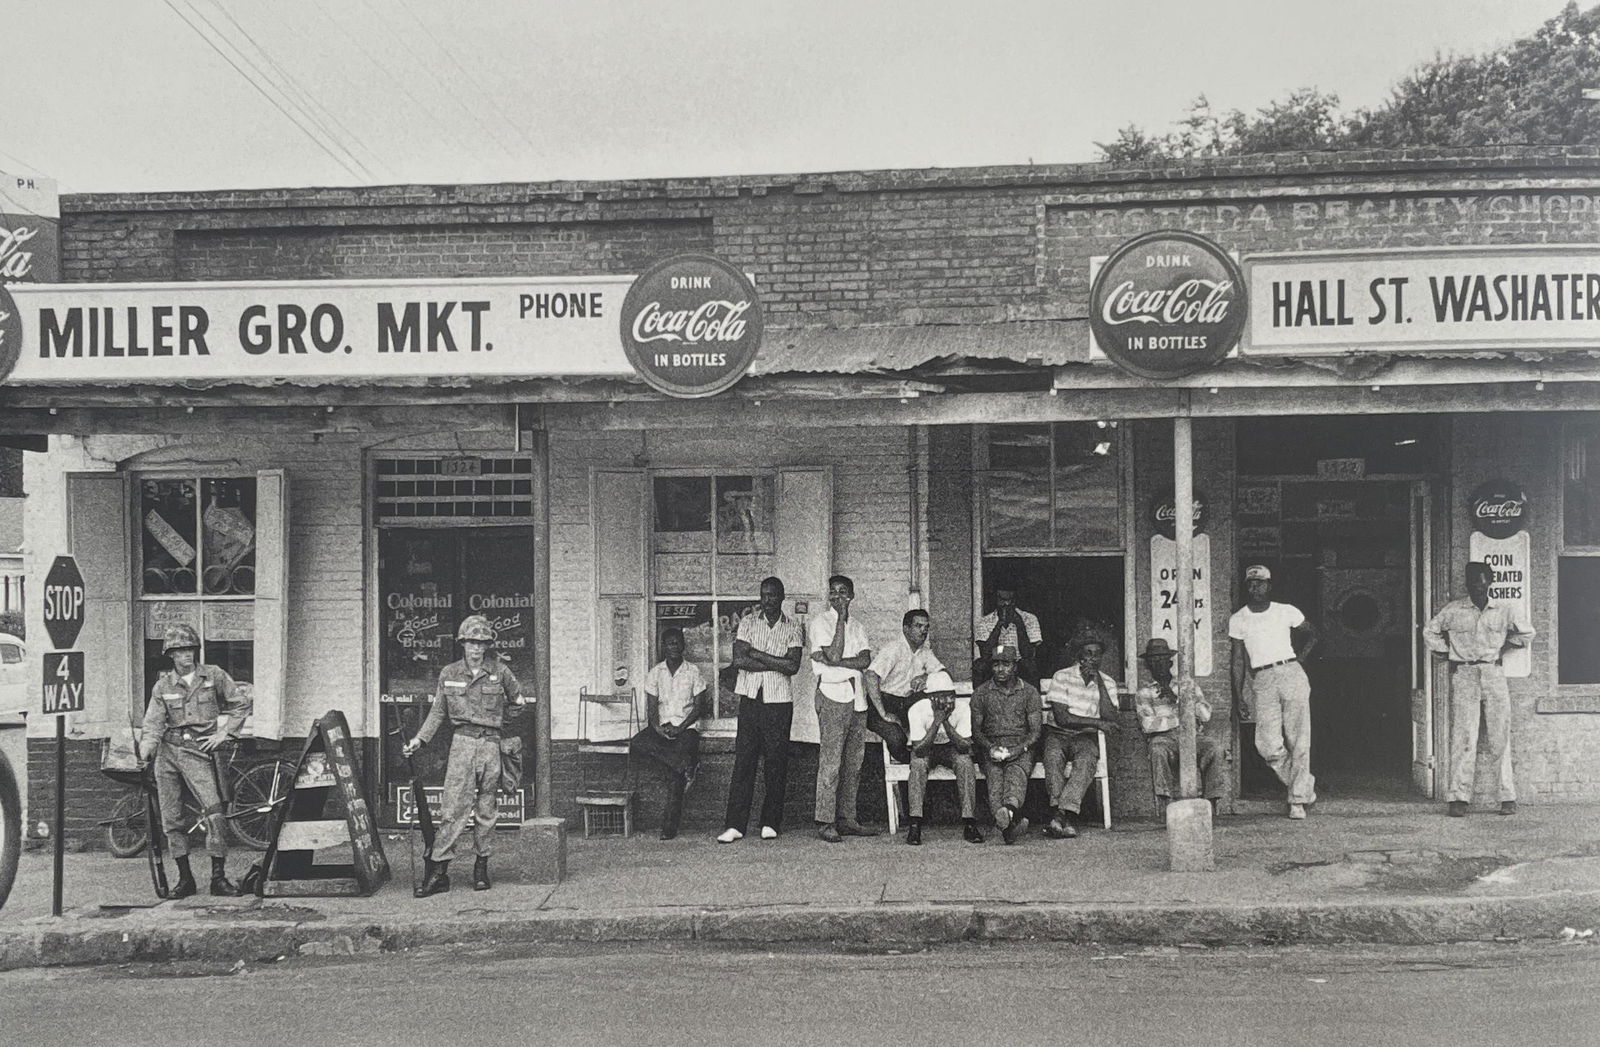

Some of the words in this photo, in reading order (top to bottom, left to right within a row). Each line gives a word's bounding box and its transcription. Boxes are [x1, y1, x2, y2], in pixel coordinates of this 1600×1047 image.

[1146, 255, 1191, 267] DRINK
[671, 276, 711, 289] DRINK
[1102, 279, 1234, 325] Coca-Cola
[1272, 279, 1354, 328] HALL
[1368, 277, 1412, 325] ST.
[1429, 273, 1600, 323] WASHATER
[40, 305, 210, 358] MILLER
[238, 303, 353, 355] GRO.
[377, 301, 493, 353] MKT.
[519, 293, 603, 319] PHONE
[632, 300, 752, 342] Coca-Cola
[1127, 337, 1144, 350] IN
[1149, 336, 1207, 350] BOTTLES
[654, 354, 669, 367] IN
[672, 353, 726, 367] BOTTLES
[1476, 500, 1523, 518] Coca-Cola
[1484, 554, 1513, 567] COIN
[1160, 568, 1202, 581] OPN
[1492, 570, 1523, 583] ERATED
[1489, 586, 1522, 600] ASHERS
[45, 585, 83, 620] STOP
[387, 593, 453, 610] Colonial
[469, 593, 534, 611] Colonial
[673, 606, 697, 616] SELL
[403, 637, 442, 649] Bread
[491, 637, 525, 649] read
[56, 655, 70, 681] 4
[44, 682, 83, 712] WAY
